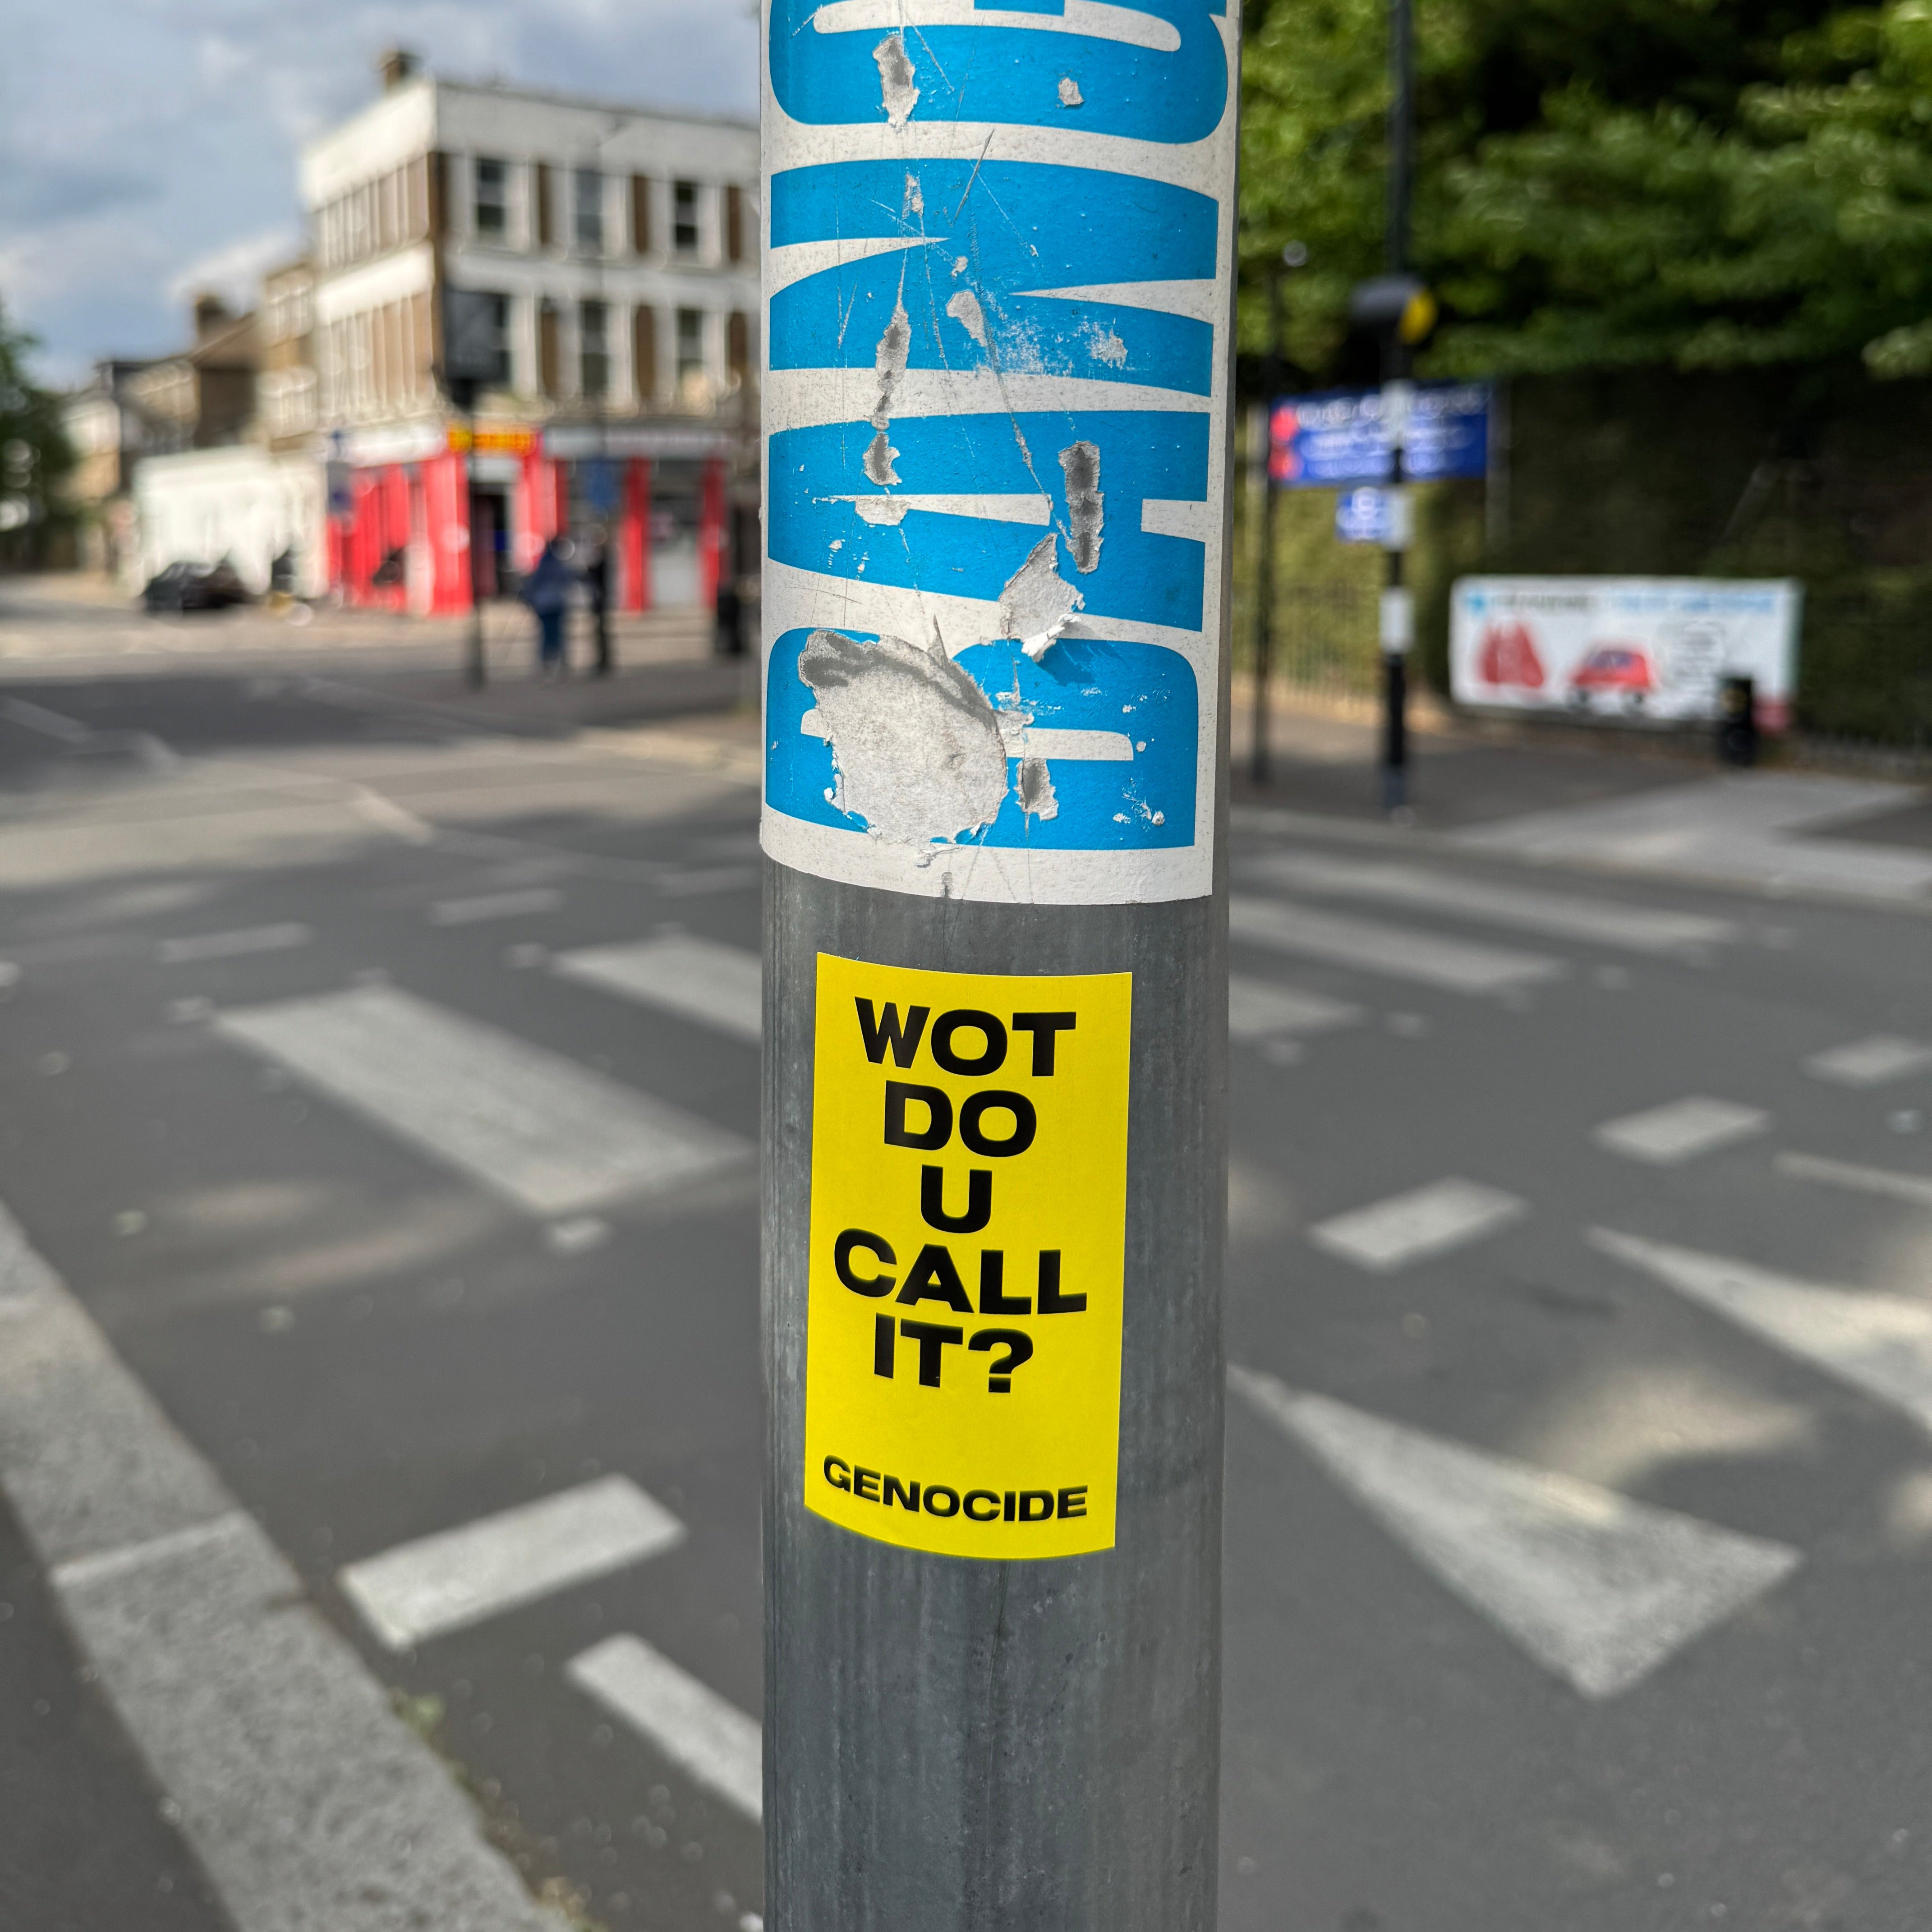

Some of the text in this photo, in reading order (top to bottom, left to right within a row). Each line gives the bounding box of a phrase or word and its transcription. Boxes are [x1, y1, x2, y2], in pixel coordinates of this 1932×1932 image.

[855, 996, 1076, 1077] WOT
[884, 1080, 1037, 1158] DO
[920, 1164, 992, 1234] U
[834, 1228, 1087, 1315] CALL
[874, 1313, 1033, 1394] IT?
[823, 1456, 1088, 1522] GENOCIDE
